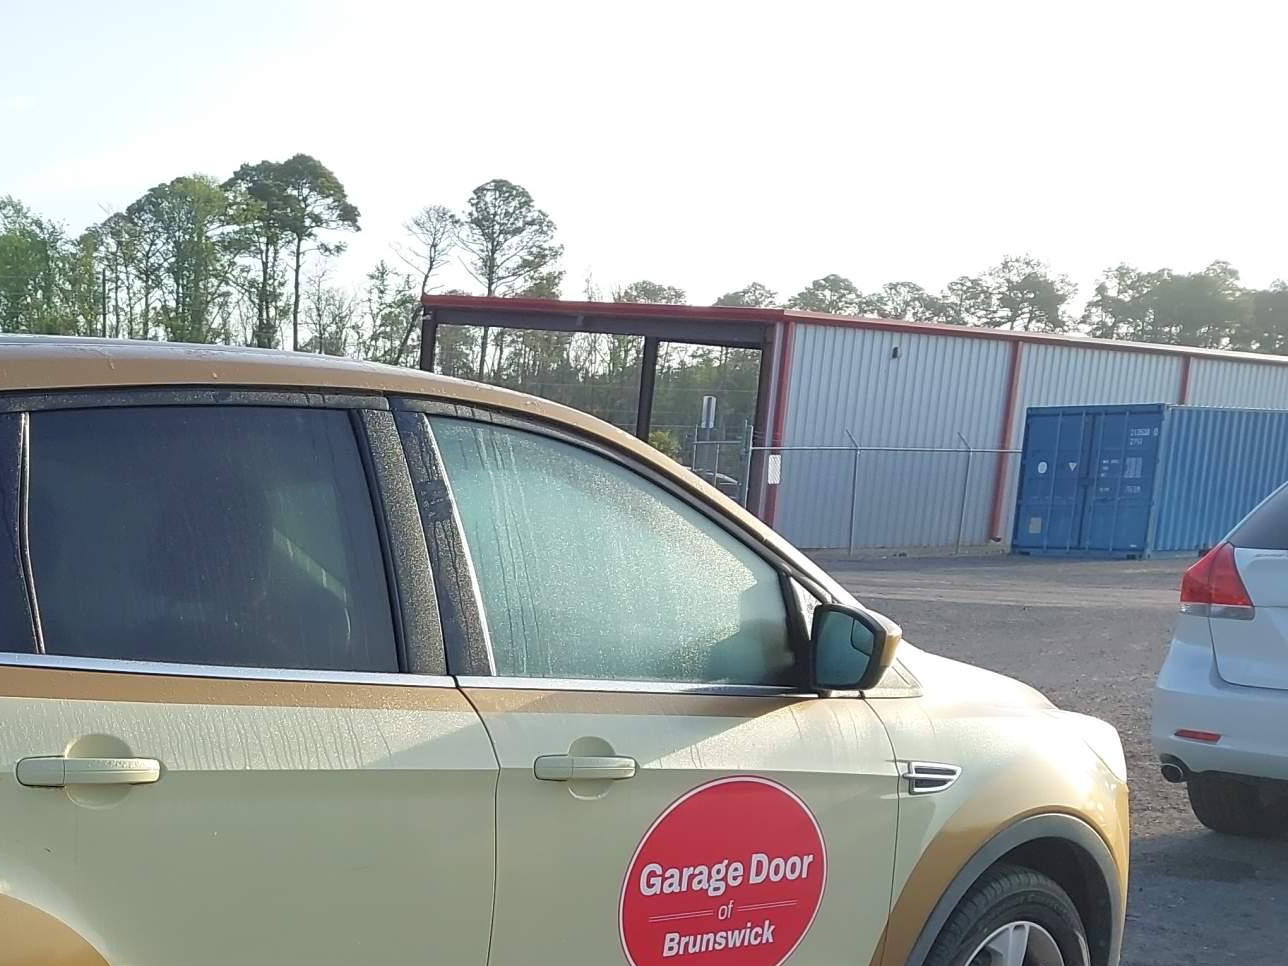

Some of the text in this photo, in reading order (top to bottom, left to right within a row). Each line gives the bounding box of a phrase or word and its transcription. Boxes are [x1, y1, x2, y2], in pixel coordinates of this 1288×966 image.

[639, 853, 814, 896] Garage Door
[718, 900, 734, 920] of
[662, 920, 776, 957] Brunswick
